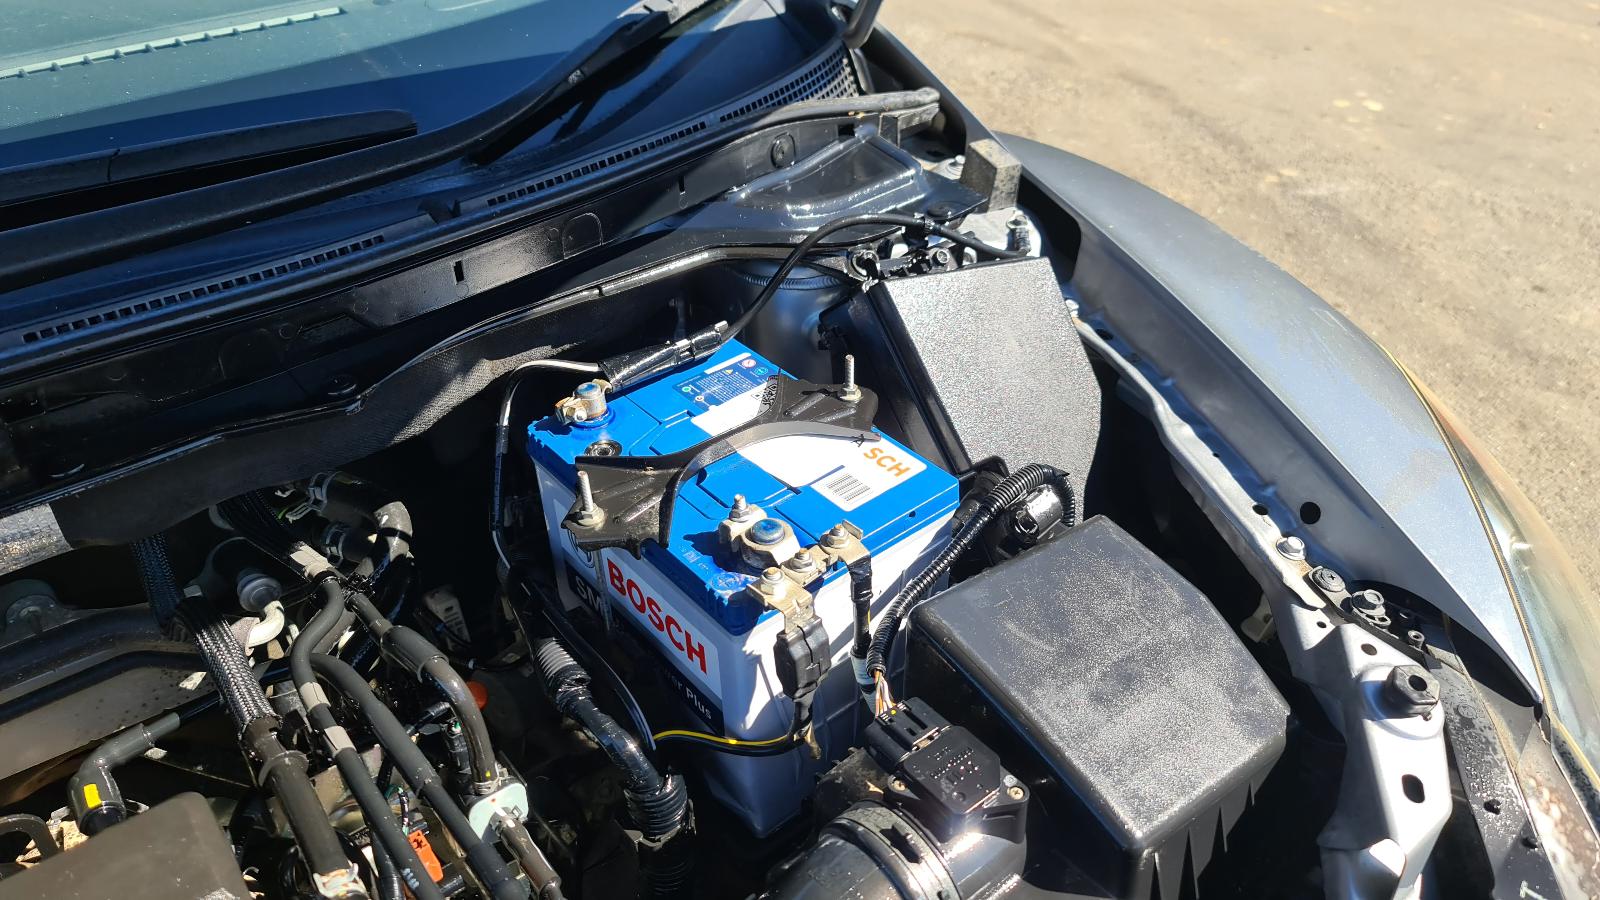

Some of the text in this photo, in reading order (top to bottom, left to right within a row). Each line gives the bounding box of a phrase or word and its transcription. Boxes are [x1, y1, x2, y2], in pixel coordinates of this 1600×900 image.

[863, 447, 911, 477] SCH
[607, 559, 707, 674] BOSCH
[686, 688, 712, 720] Plus
